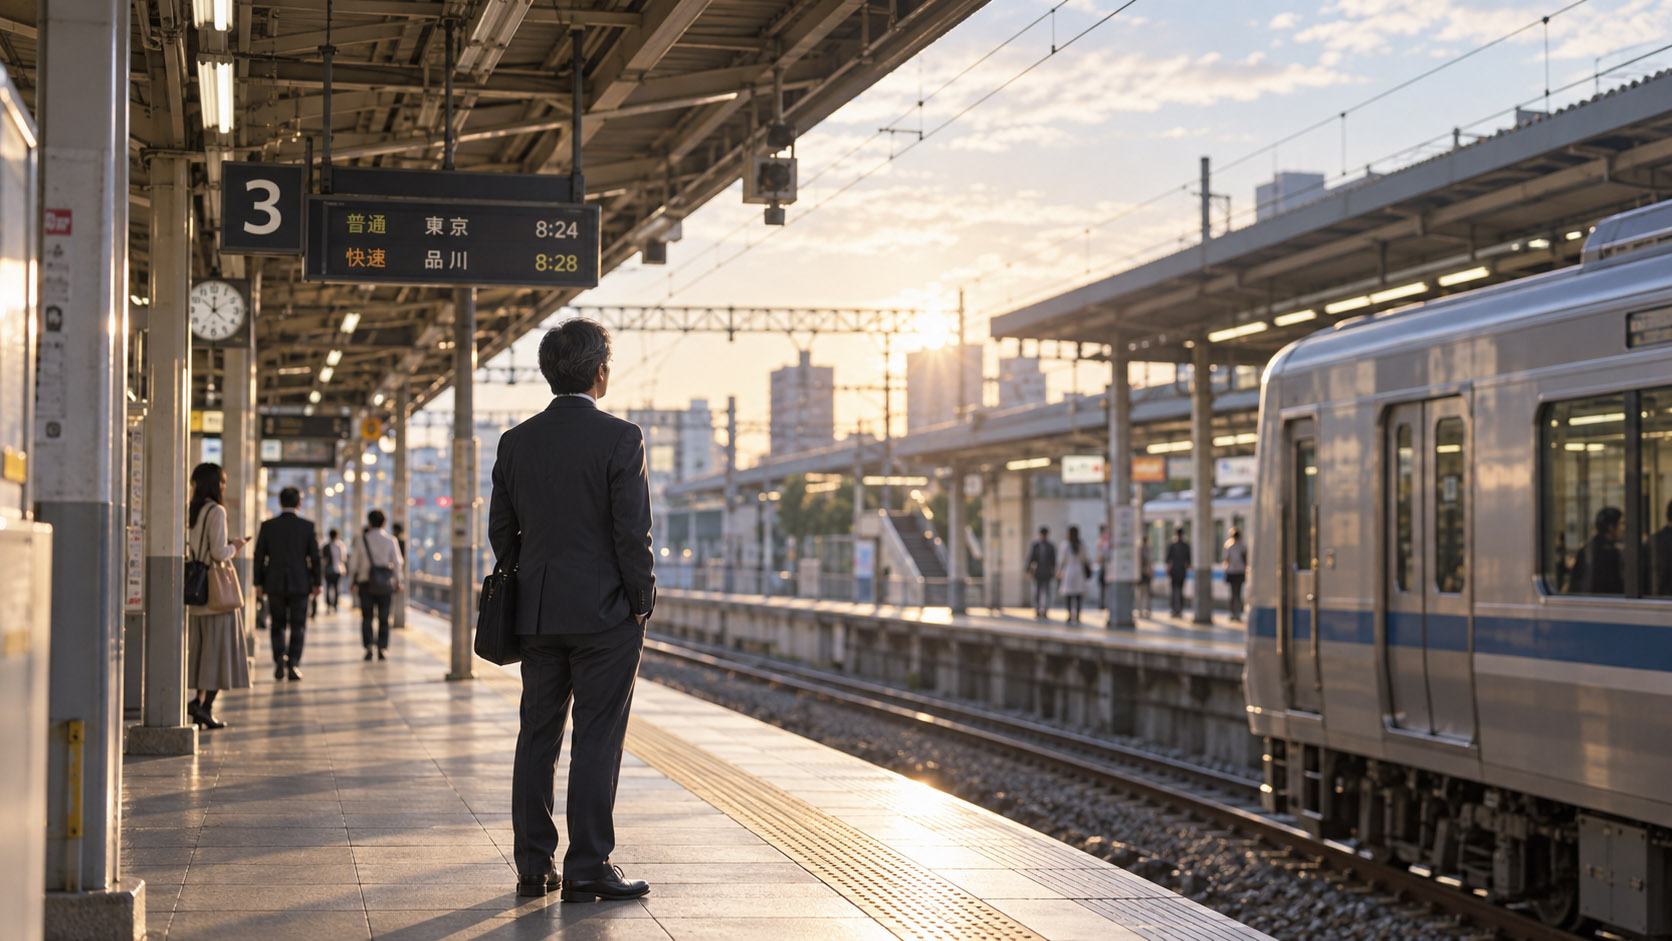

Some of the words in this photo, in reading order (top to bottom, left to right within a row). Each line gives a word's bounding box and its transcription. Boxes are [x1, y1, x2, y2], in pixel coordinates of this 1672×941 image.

[244, 179, 282, 235] 3
[346, 213, 386, 234] 普通
[425, 216, 469, 237] 東京
[536, 220, 578, 239] 8:24
[345, 247, 386, 268] 快速
[424, 250, 467, 270] 品川
[535, 253, 578, 272] 8:28
